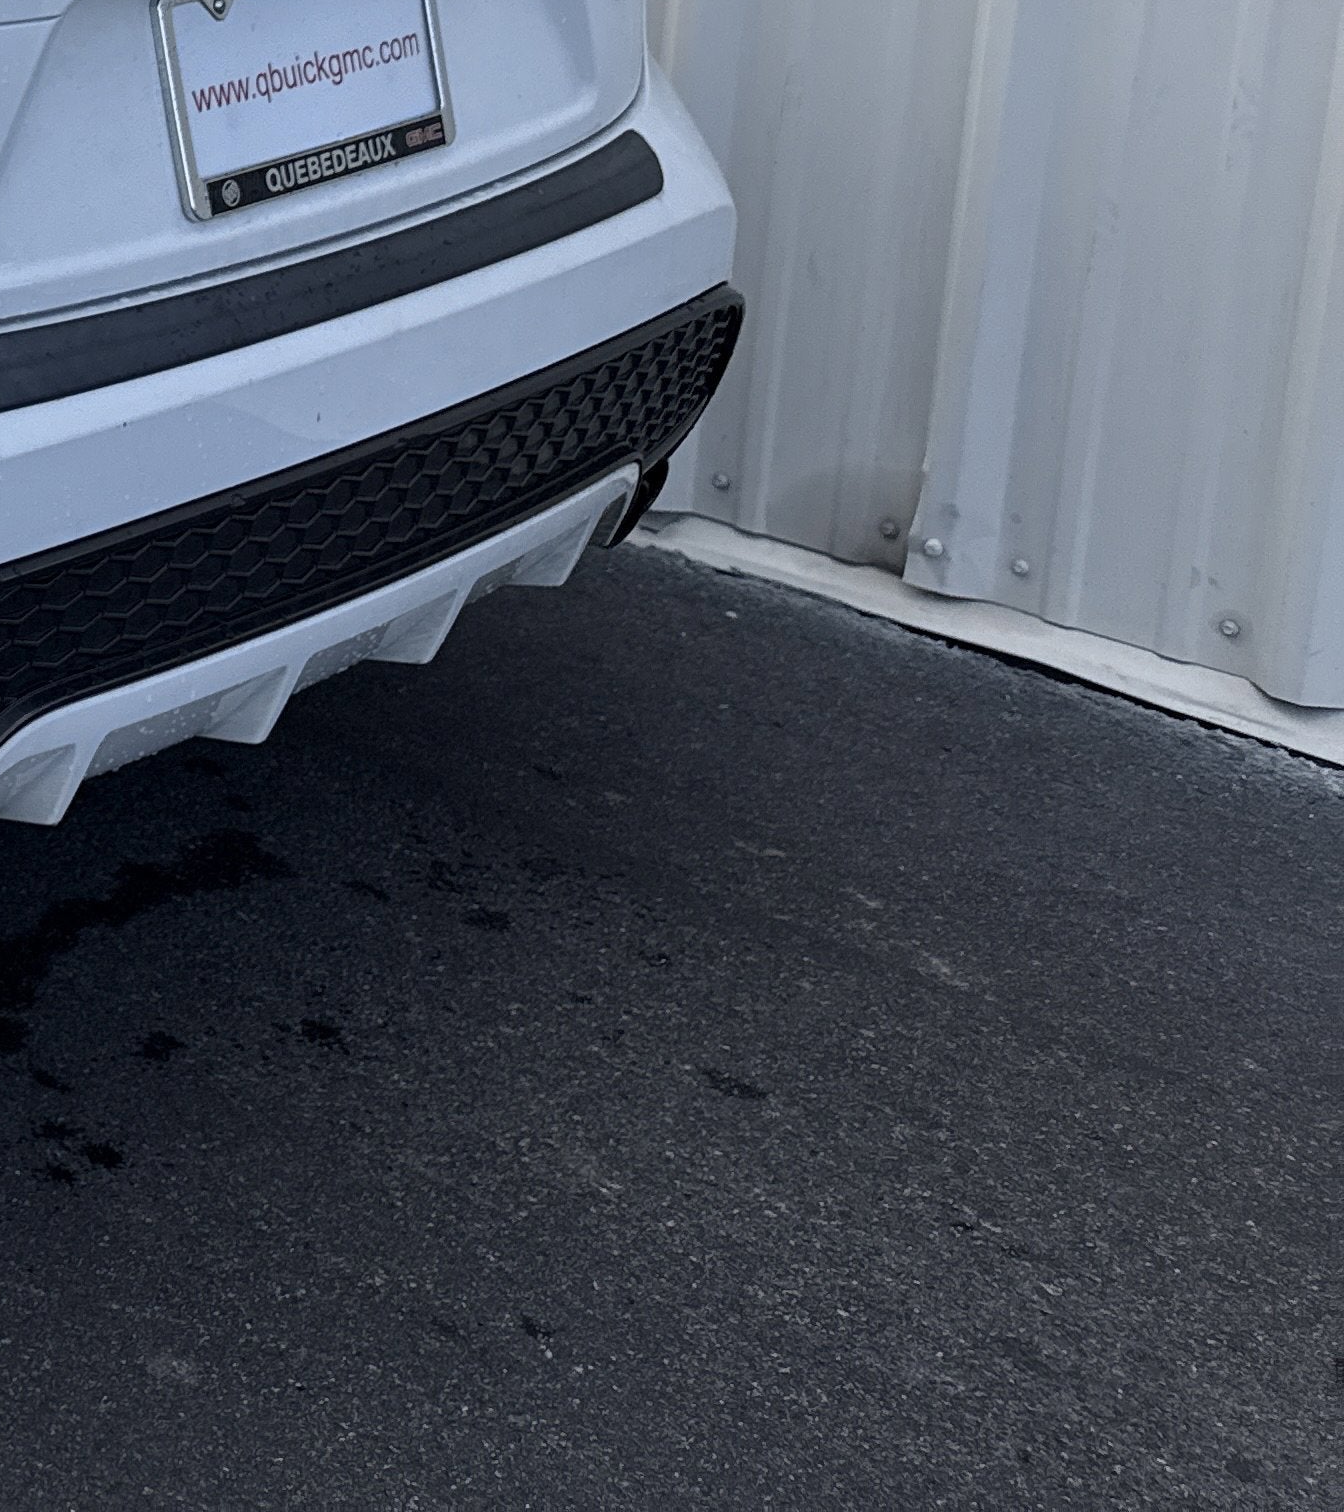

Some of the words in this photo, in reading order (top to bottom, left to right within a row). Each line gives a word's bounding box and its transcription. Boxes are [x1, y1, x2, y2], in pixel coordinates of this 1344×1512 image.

[191, 33, 421, 113] www.qbuickgmc.com
[265, 132, 397, 193] QUEBEDEAUX
[405, 123, 444, 148] GMC
